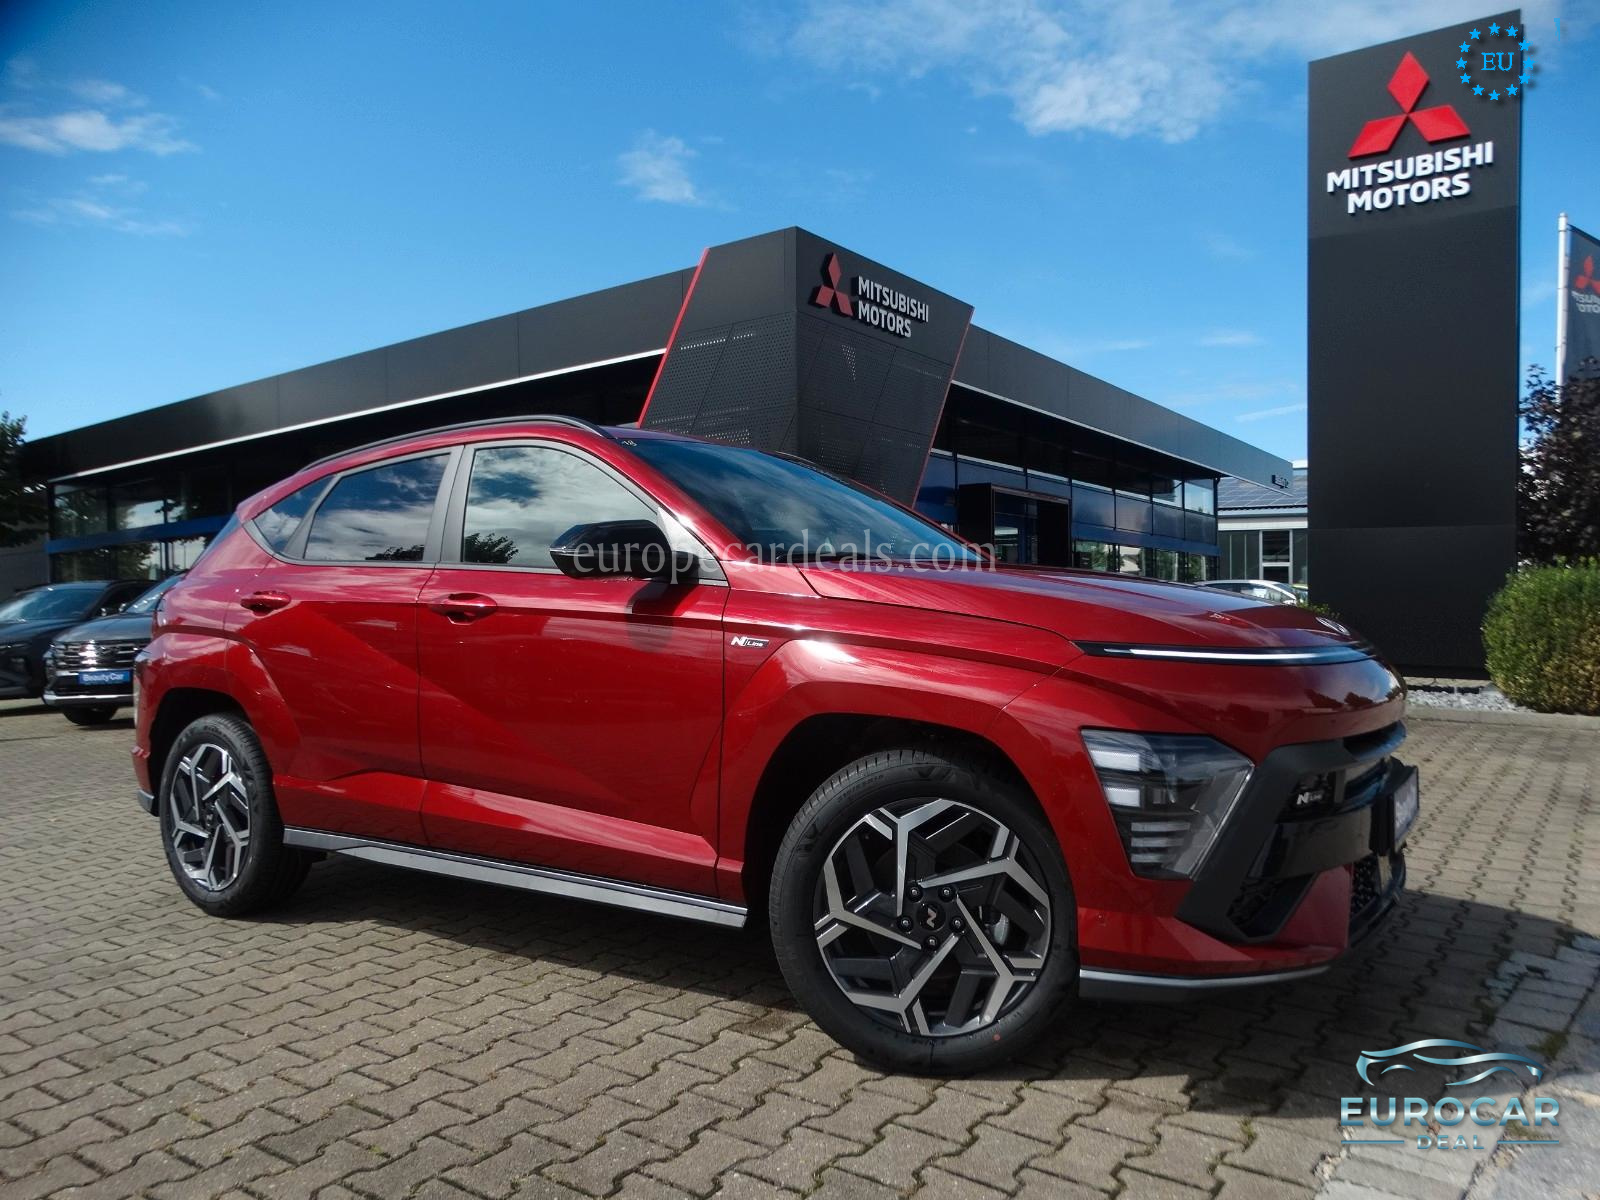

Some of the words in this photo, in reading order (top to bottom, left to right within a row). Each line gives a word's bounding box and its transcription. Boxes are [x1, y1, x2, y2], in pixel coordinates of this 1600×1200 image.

[1327, 141, 1494, 193] MITSUBISHI
[1347, 173, 1471, 214] MOTORS
[858, 275, 929, 323] MITSUBISHI
[858, 300, 912, 338] MOTORS
